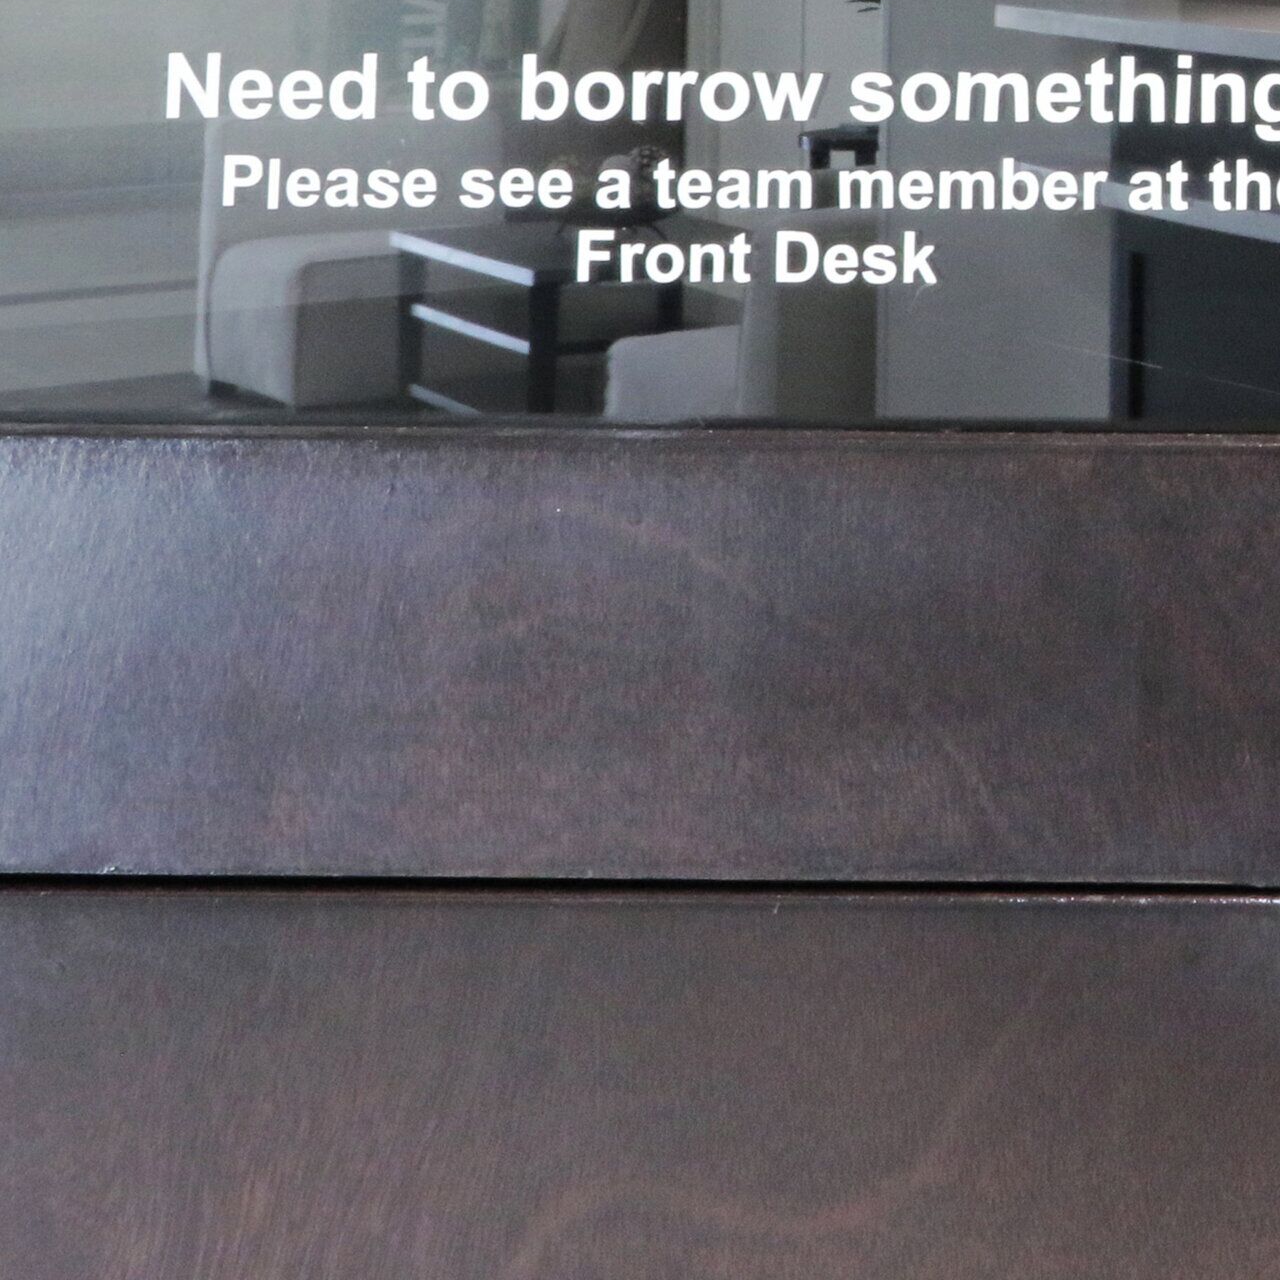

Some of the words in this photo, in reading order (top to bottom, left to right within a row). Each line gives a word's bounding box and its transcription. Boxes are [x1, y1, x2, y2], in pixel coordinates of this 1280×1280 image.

[165, 51, 379, 121] Need
[406, 55, 490, 122] to
[520, 52, 825, 123] borrow
[221, 153, 438, 211] Please
[458, 167, 574, 209] see
[595, 168, 631, 210] a
[652, 157, 813, 210] team
[838, 156, 1109, 212] member
[1127, 159, 1190, 212] at
[576, 229, 752, 284] Front
[774, 229, 938, 285] Desk
